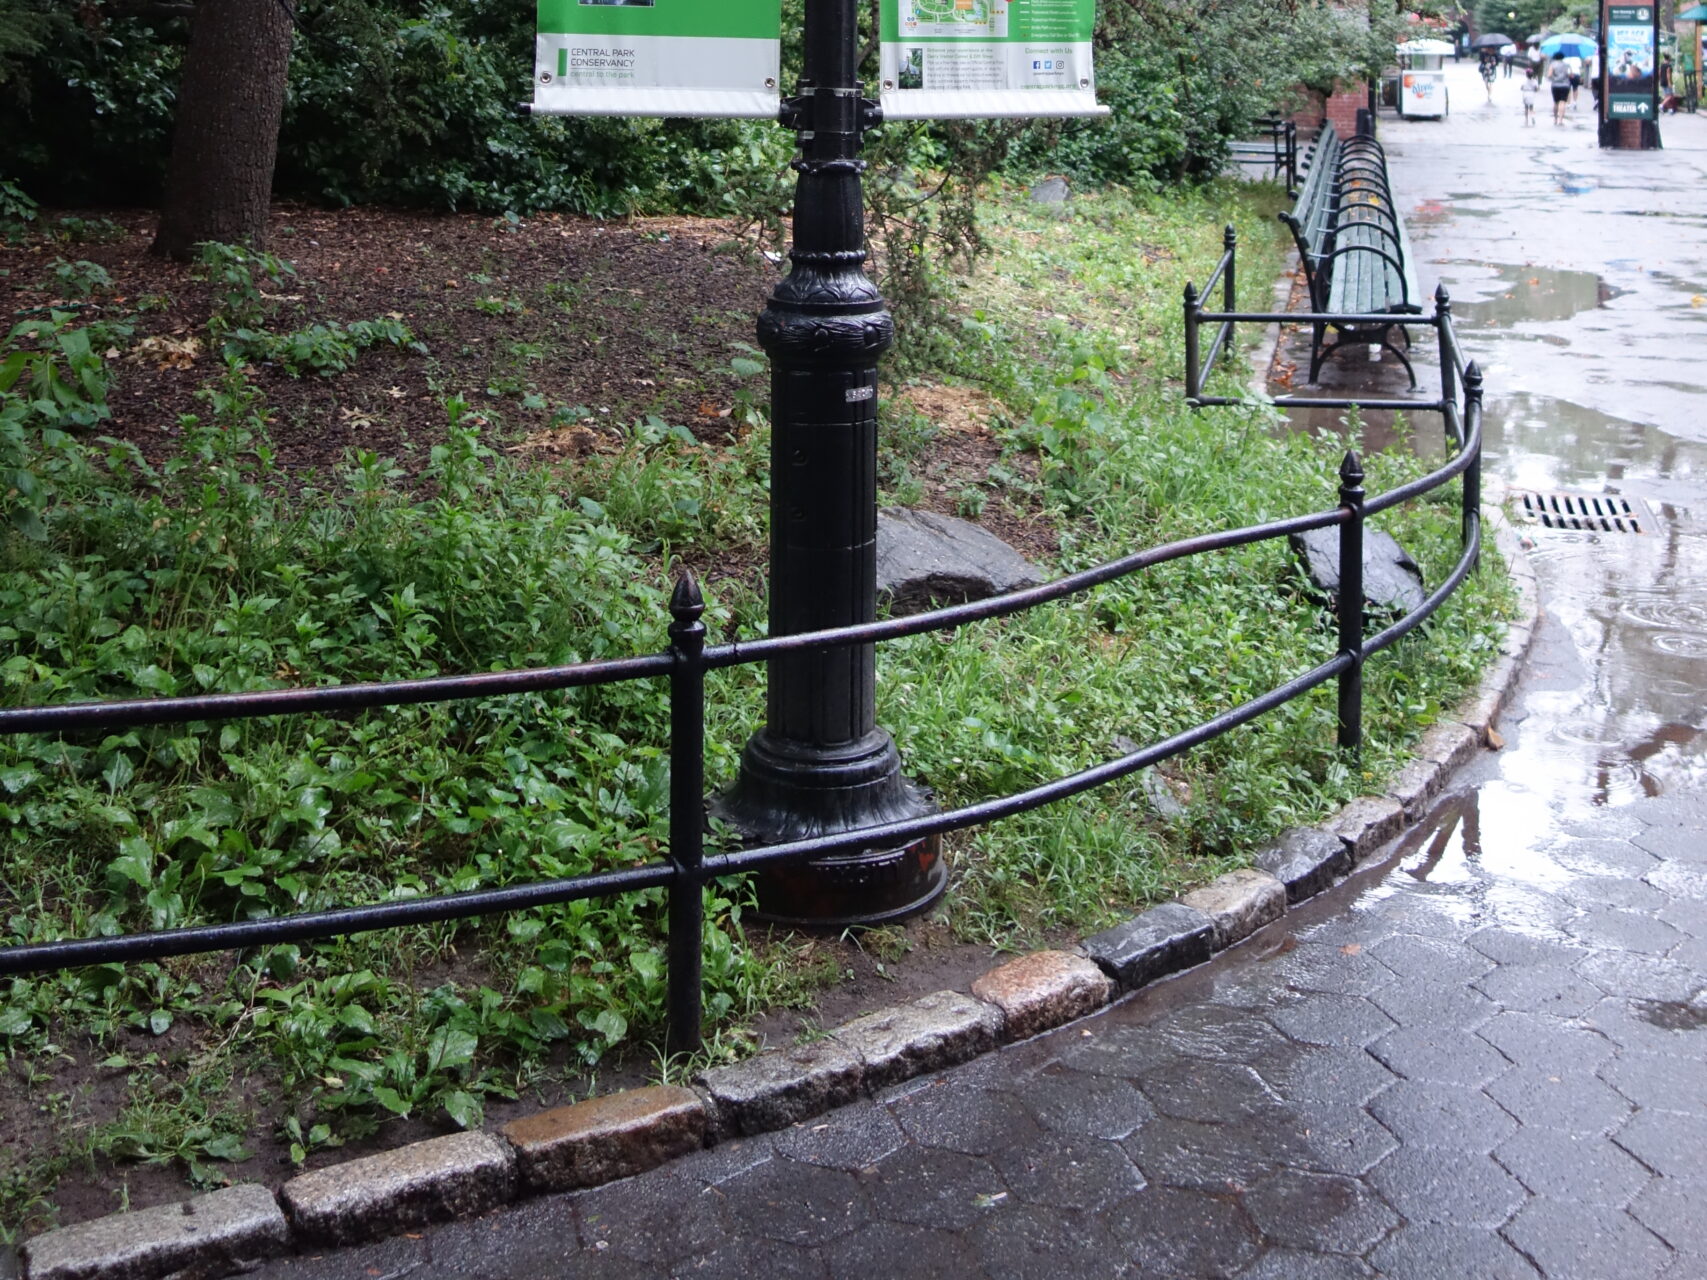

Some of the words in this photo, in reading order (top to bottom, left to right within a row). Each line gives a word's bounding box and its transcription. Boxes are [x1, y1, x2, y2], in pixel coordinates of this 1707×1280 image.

[571, 48, 610, 56] CENTRAL
[613, 49, 635, 57] PARK
[571, 58, 635, 67] CONSERVANCY
